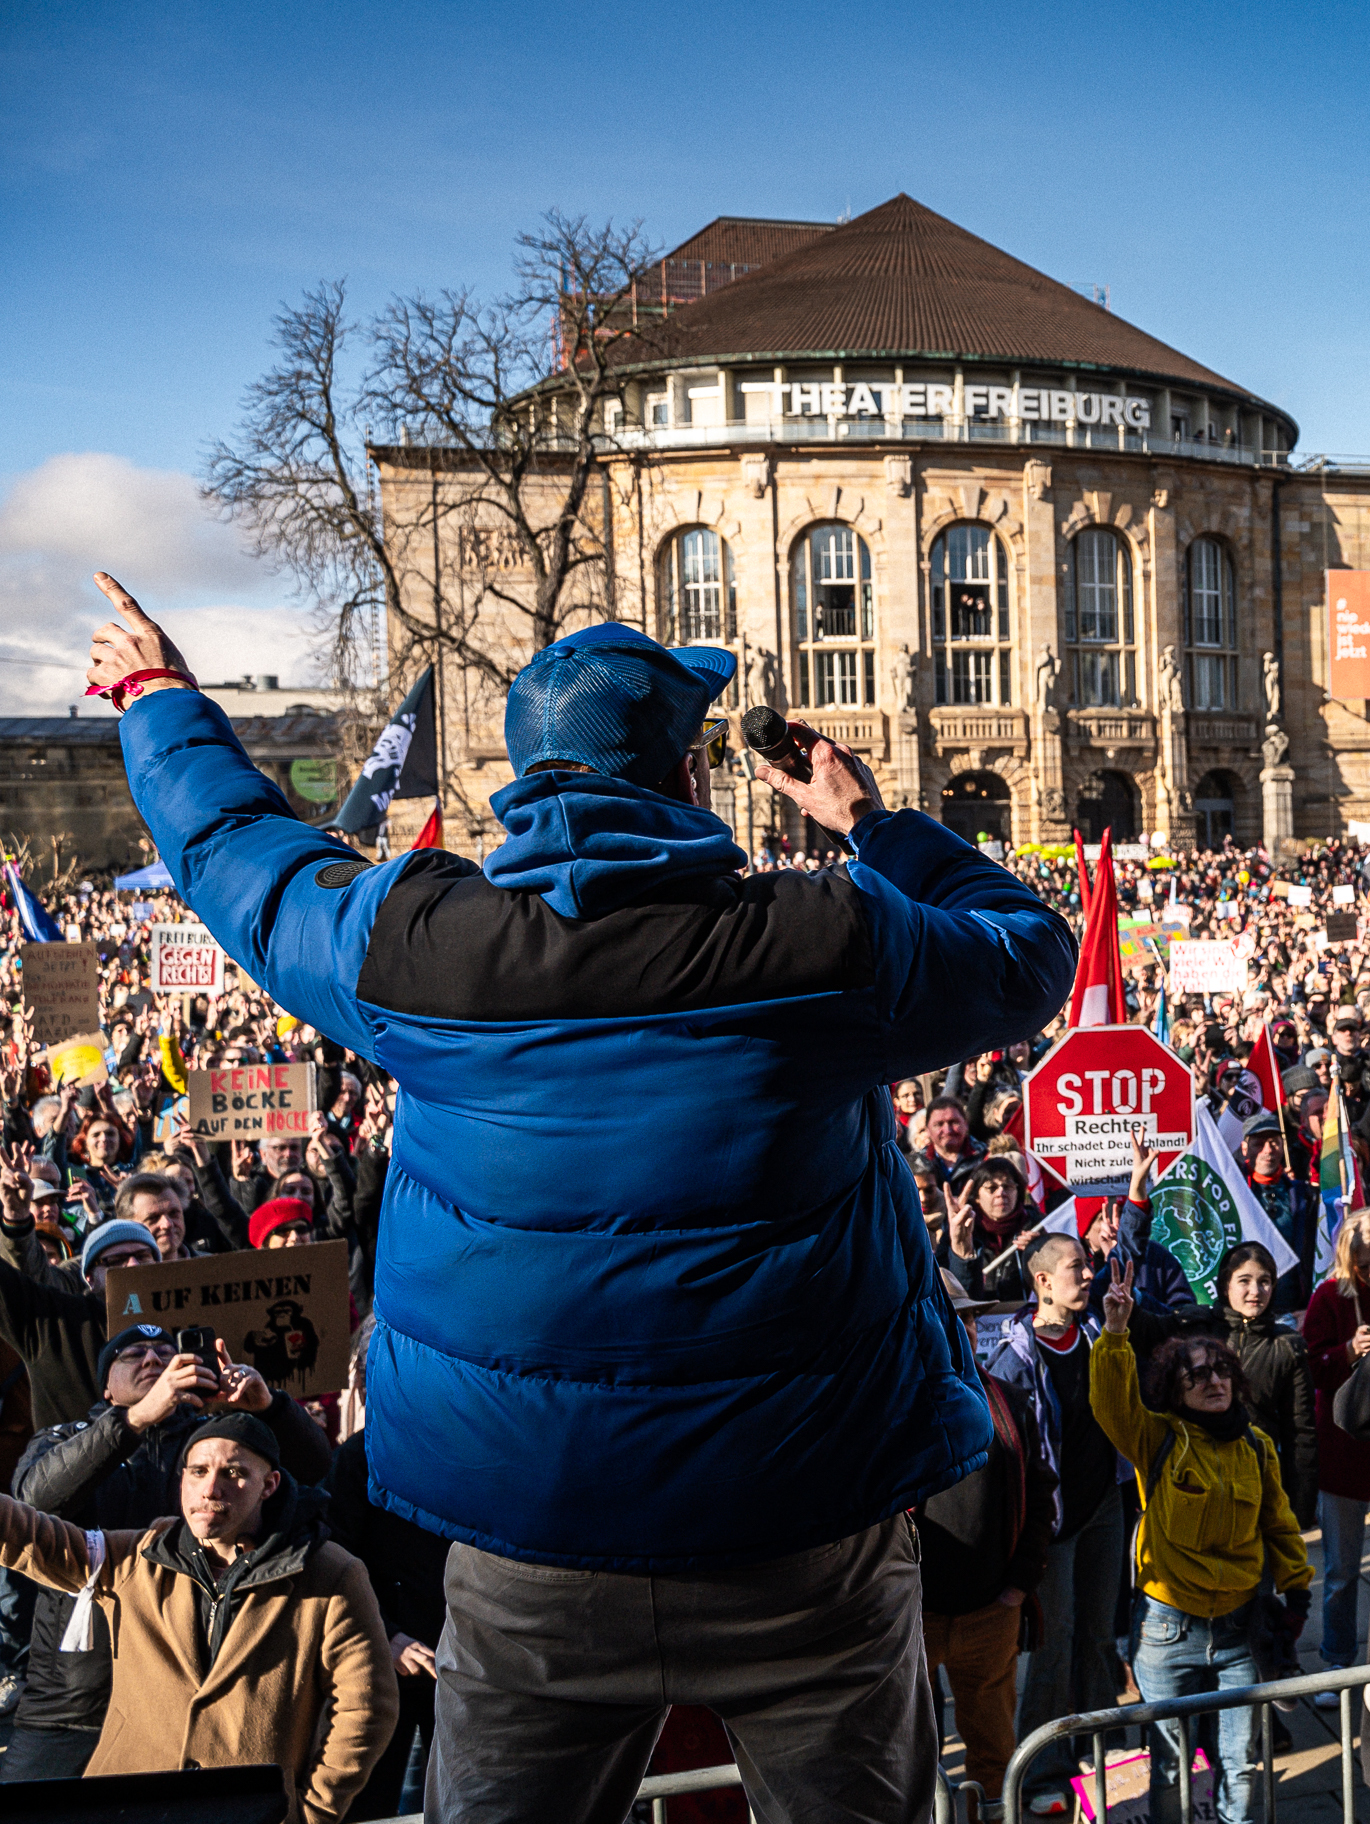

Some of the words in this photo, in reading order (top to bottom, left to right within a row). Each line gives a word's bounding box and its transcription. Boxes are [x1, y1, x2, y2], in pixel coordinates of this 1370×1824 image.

[770, 381, 953, 418] THEATER
[964, 384, 1151, 429] FREIBURG
[1335, 646, 1368, 661] jetzt
[160, 946, 214, 965] GEGEN
[212, 1089, 293, 1114] BÖCKE
[1056, 1067, 1166, 1117] STOP
[197, 1117, 229, 1136] AUF
[234, 1116, 263, 1130] DEN
[266, 1108, 309, 1133] HÖCKE
[1075, 1118, 1148, 1135] Rechte:
[1036, 1142, 1054, 1153] Ihr
[1058, 1140, 1103, 1152] schadet
[1108, 1136, 1185, 1150] Deuchland!
[1075, 1157, 1106, 1168] Nicht
[1201, 1172, 1231, 1212] FOR
[200, 1273, 312, 1307] KEINEN
